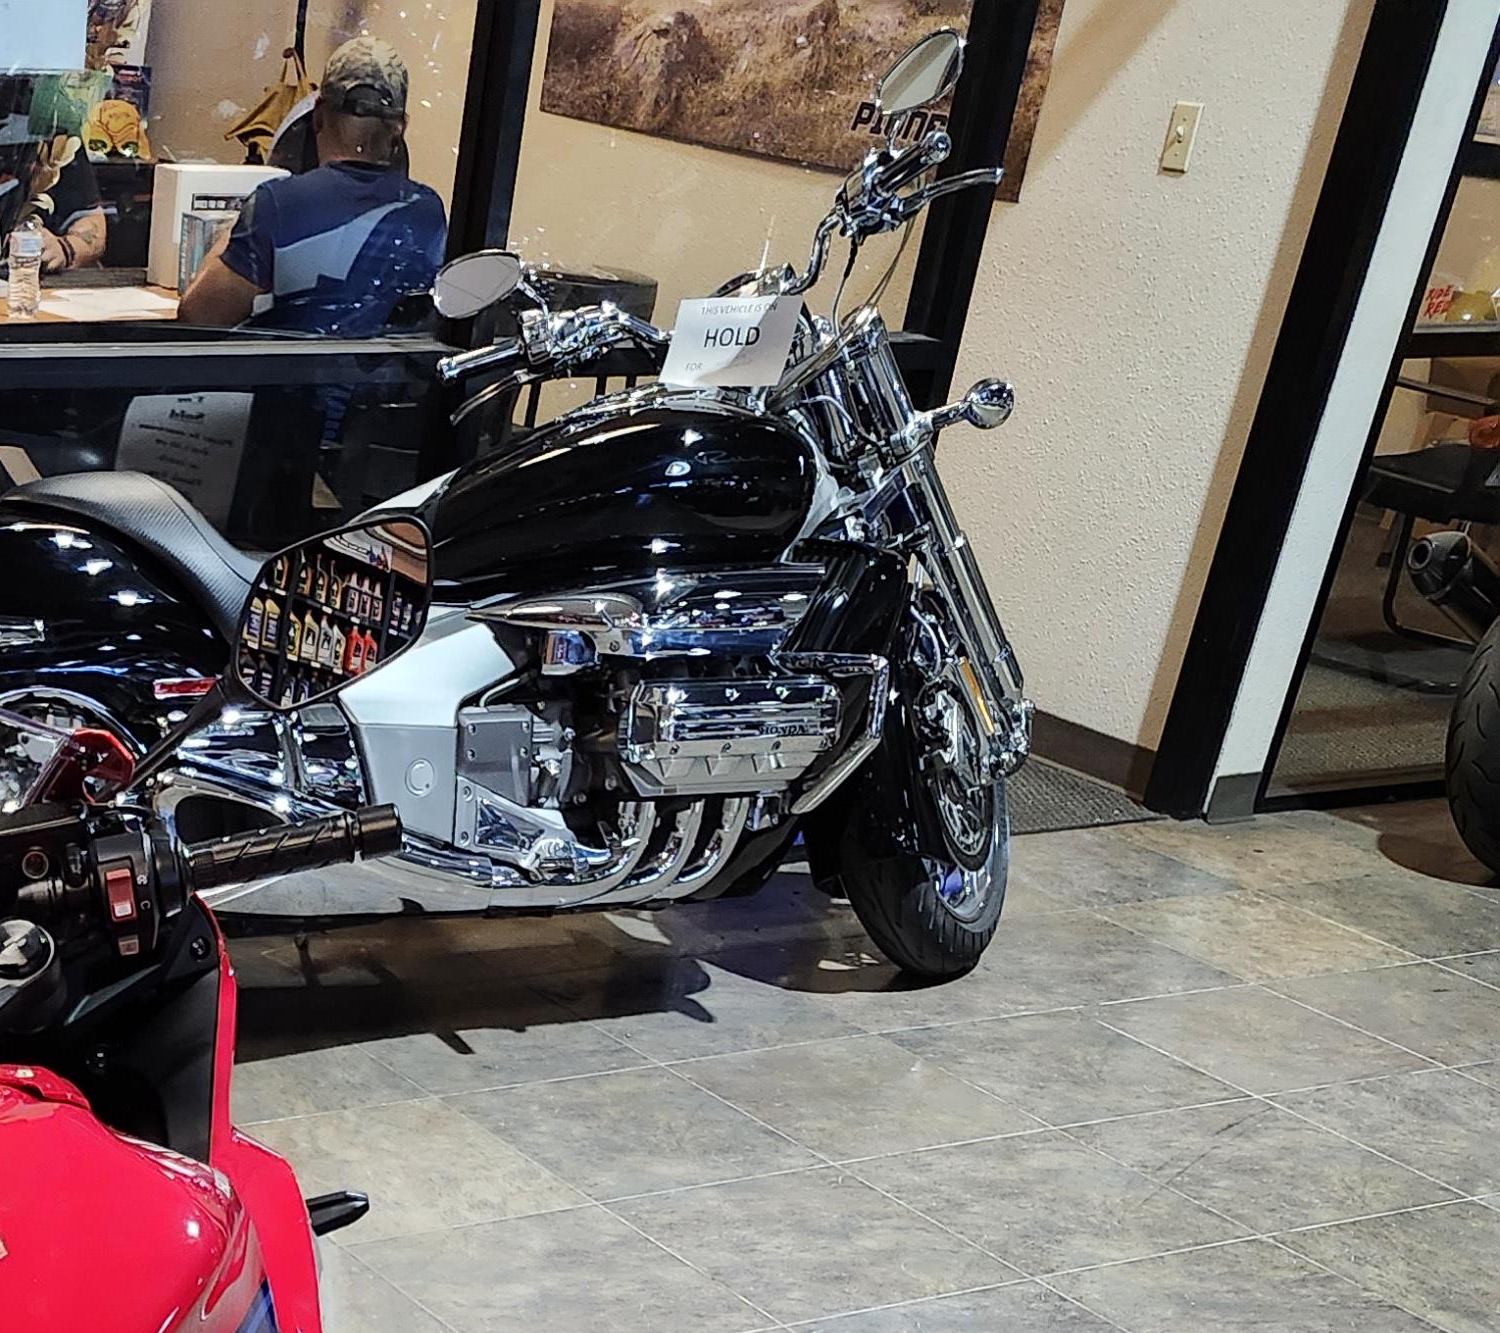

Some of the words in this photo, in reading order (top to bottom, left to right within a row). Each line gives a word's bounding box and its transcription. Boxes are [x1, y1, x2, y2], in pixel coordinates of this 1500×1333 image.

[701, 306, 718, 316] THIS
[718, 304, 752, 314] VEHICLE
[753, 303, 762, 312] IS
[763, 302, 778, 312] ON
[703, 326, 761, 348] HOLD
[685, 362, 703, 371] FOR
